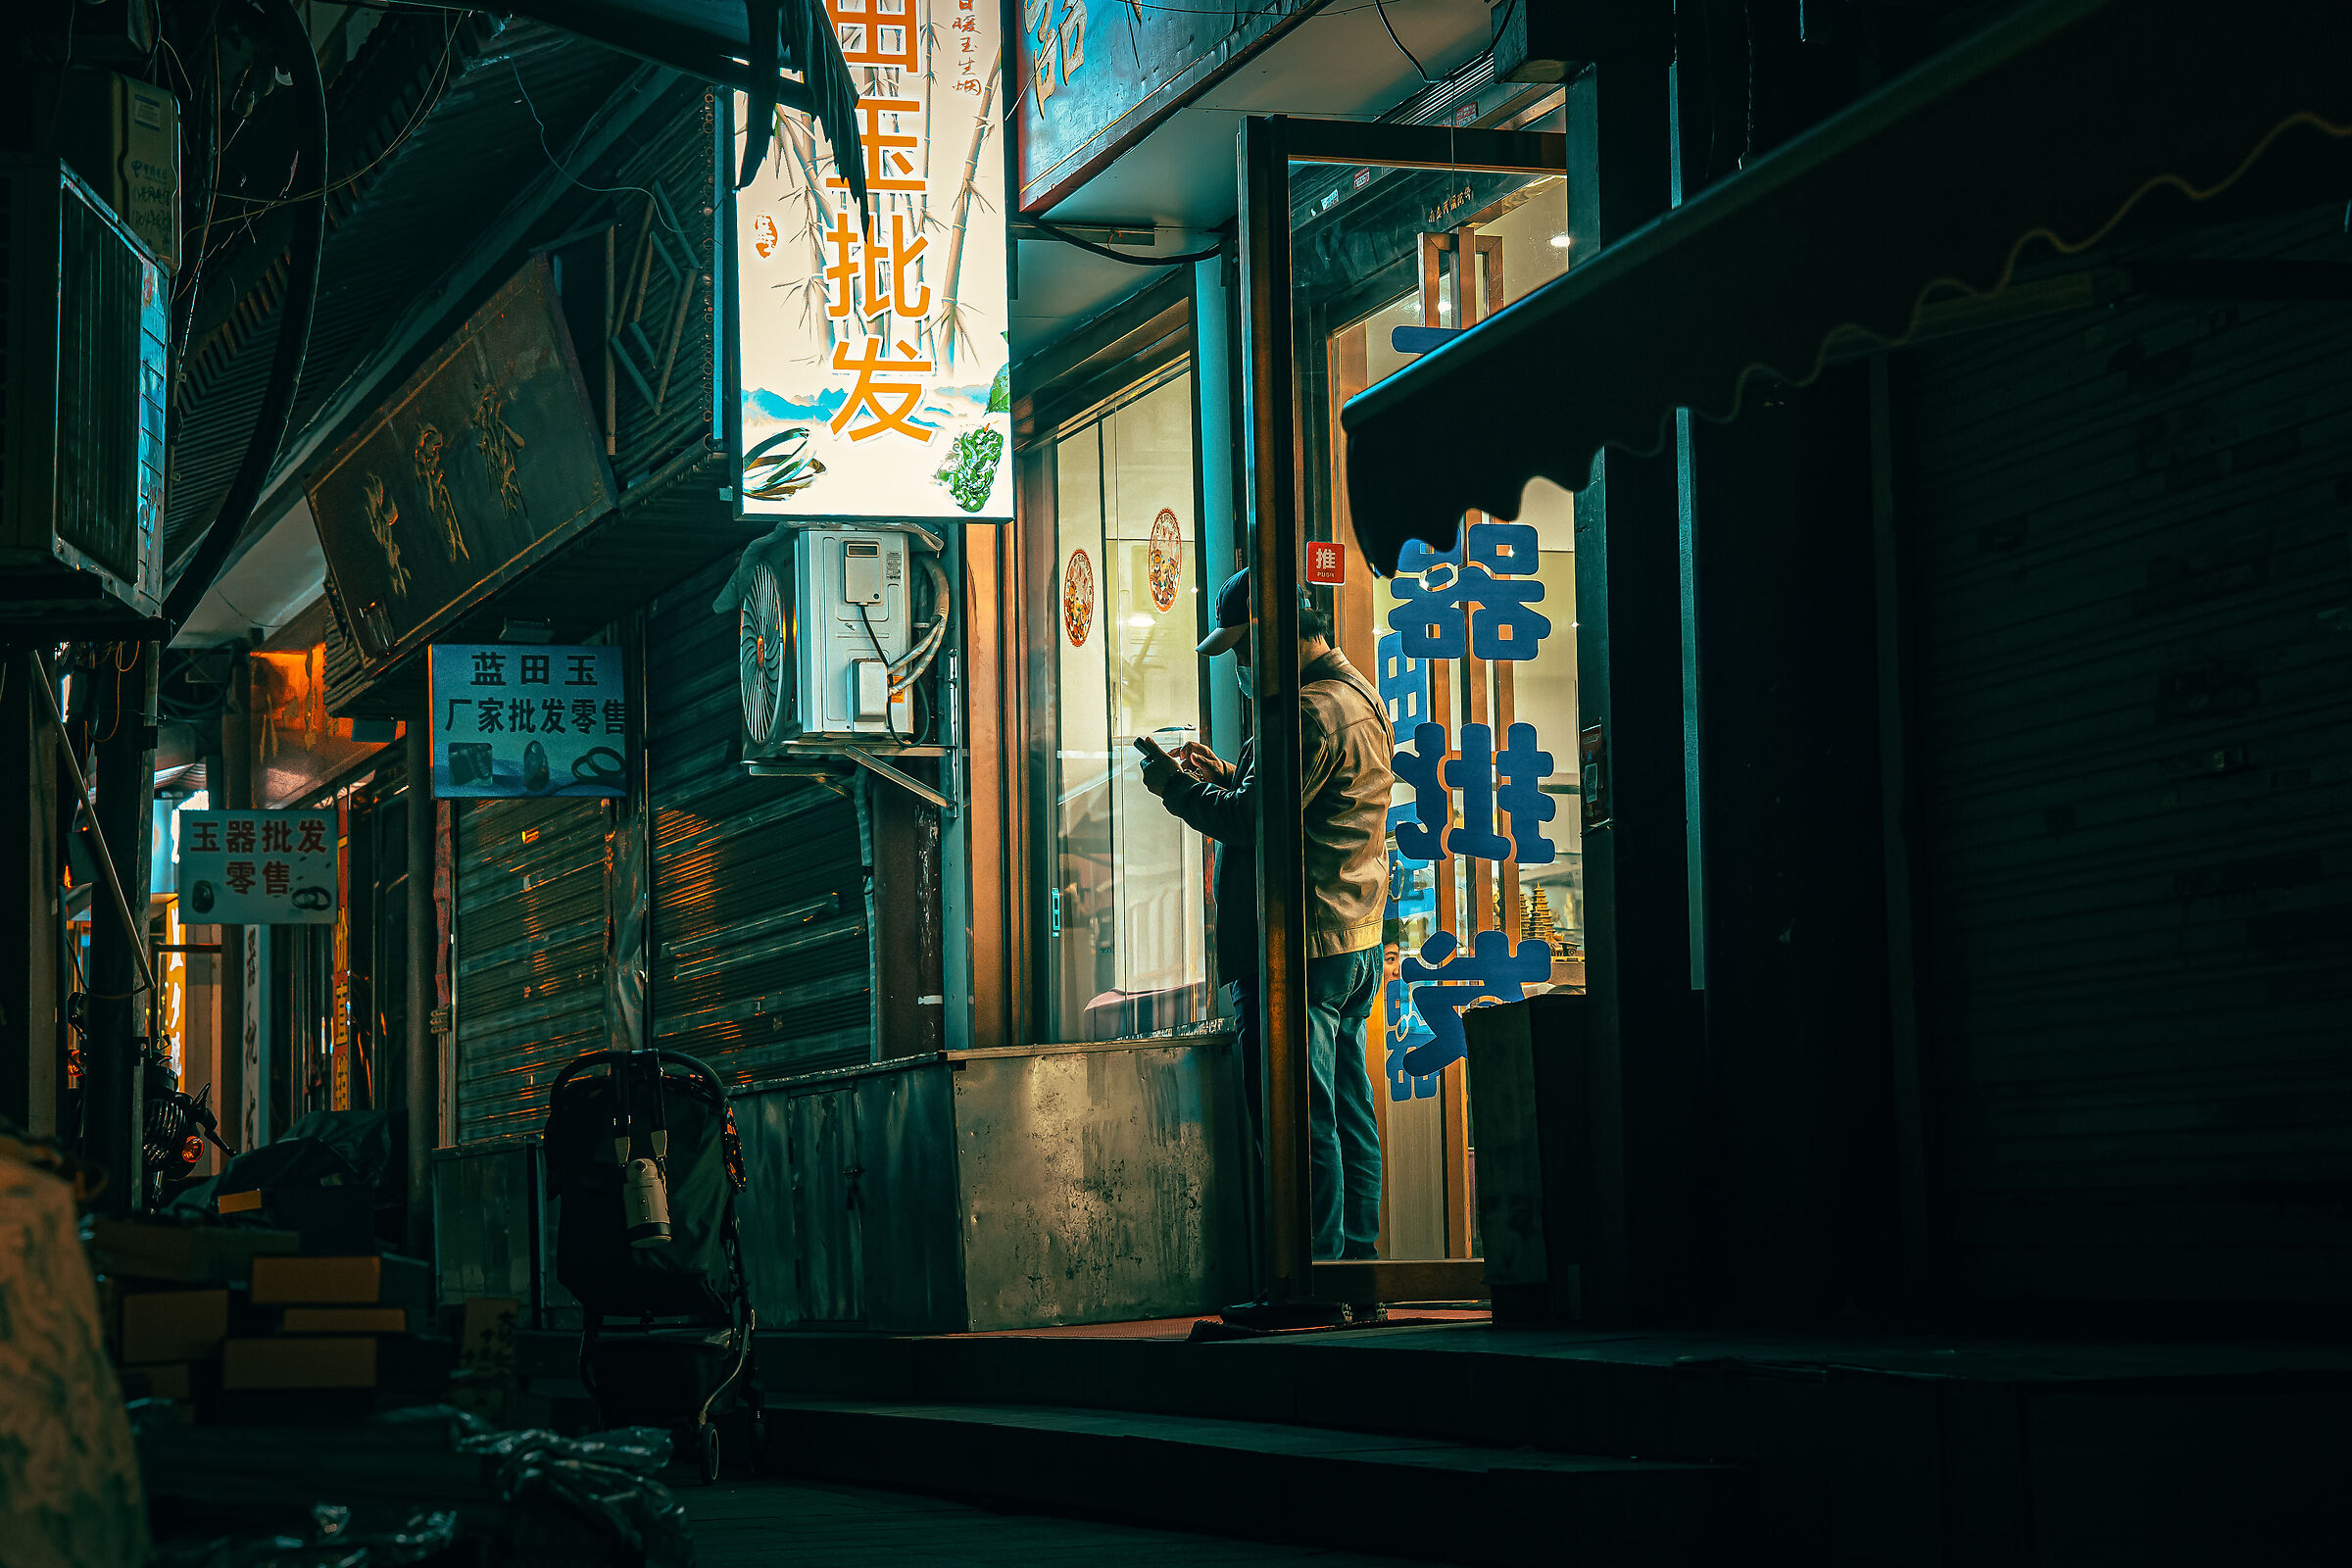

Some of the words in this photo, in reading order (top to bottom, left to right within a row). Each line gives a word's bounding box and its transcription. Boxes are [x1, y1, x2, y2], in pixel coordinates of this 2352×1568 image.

[1315, 548, 1336, 568] 推
[470, 652, 598, 685] 蓝田玉
[445, 697, 626, 735] 厂家批发零售
[189, 819, 327, 854] 玉器批发
[225, 860, 291, 896] 零售
